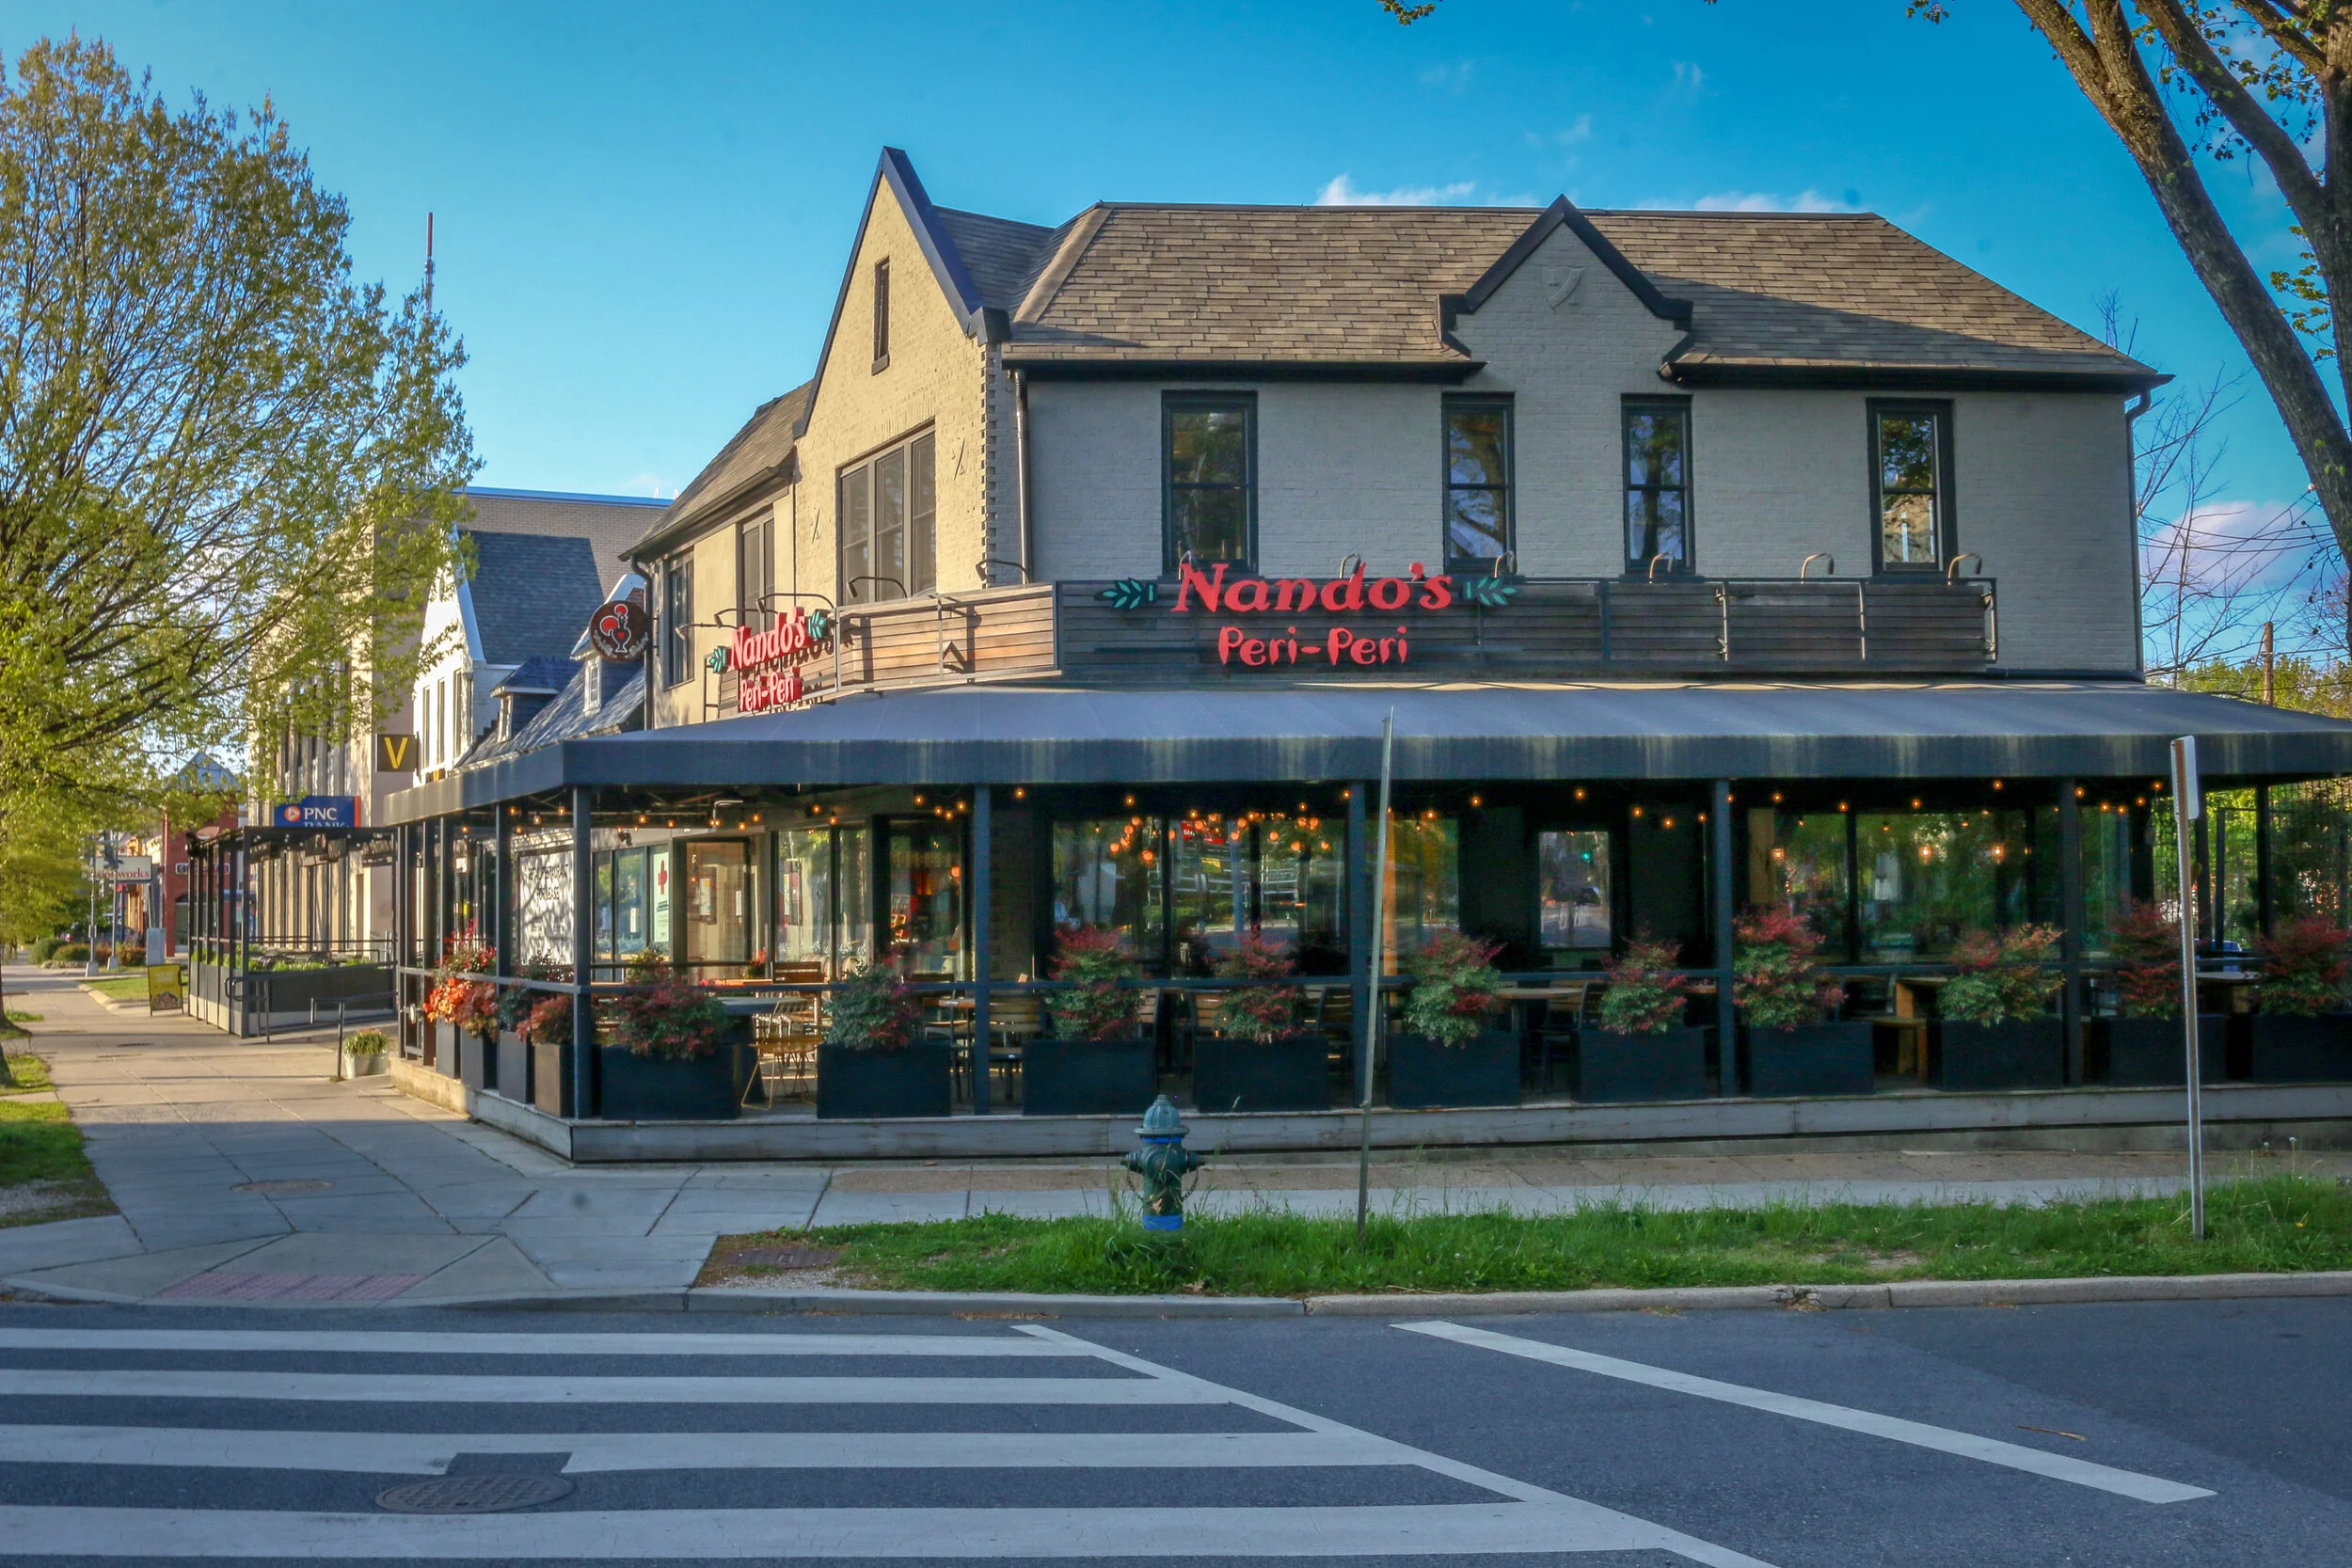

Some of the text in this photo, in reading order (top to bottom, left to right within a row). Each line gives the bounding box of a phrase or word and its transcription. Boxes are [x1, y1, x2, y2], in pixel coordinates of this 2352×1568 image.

[1170, 562, 1452, 612] Nando's
[727, 606, 806, 672] Nando's
[1217, 626, 1407, 666] Peri-Peri
[739, 667, 798, 712] Peri-Peri
[384, 736, 408, 769] V
[304, 807, 338, 821] PNC
